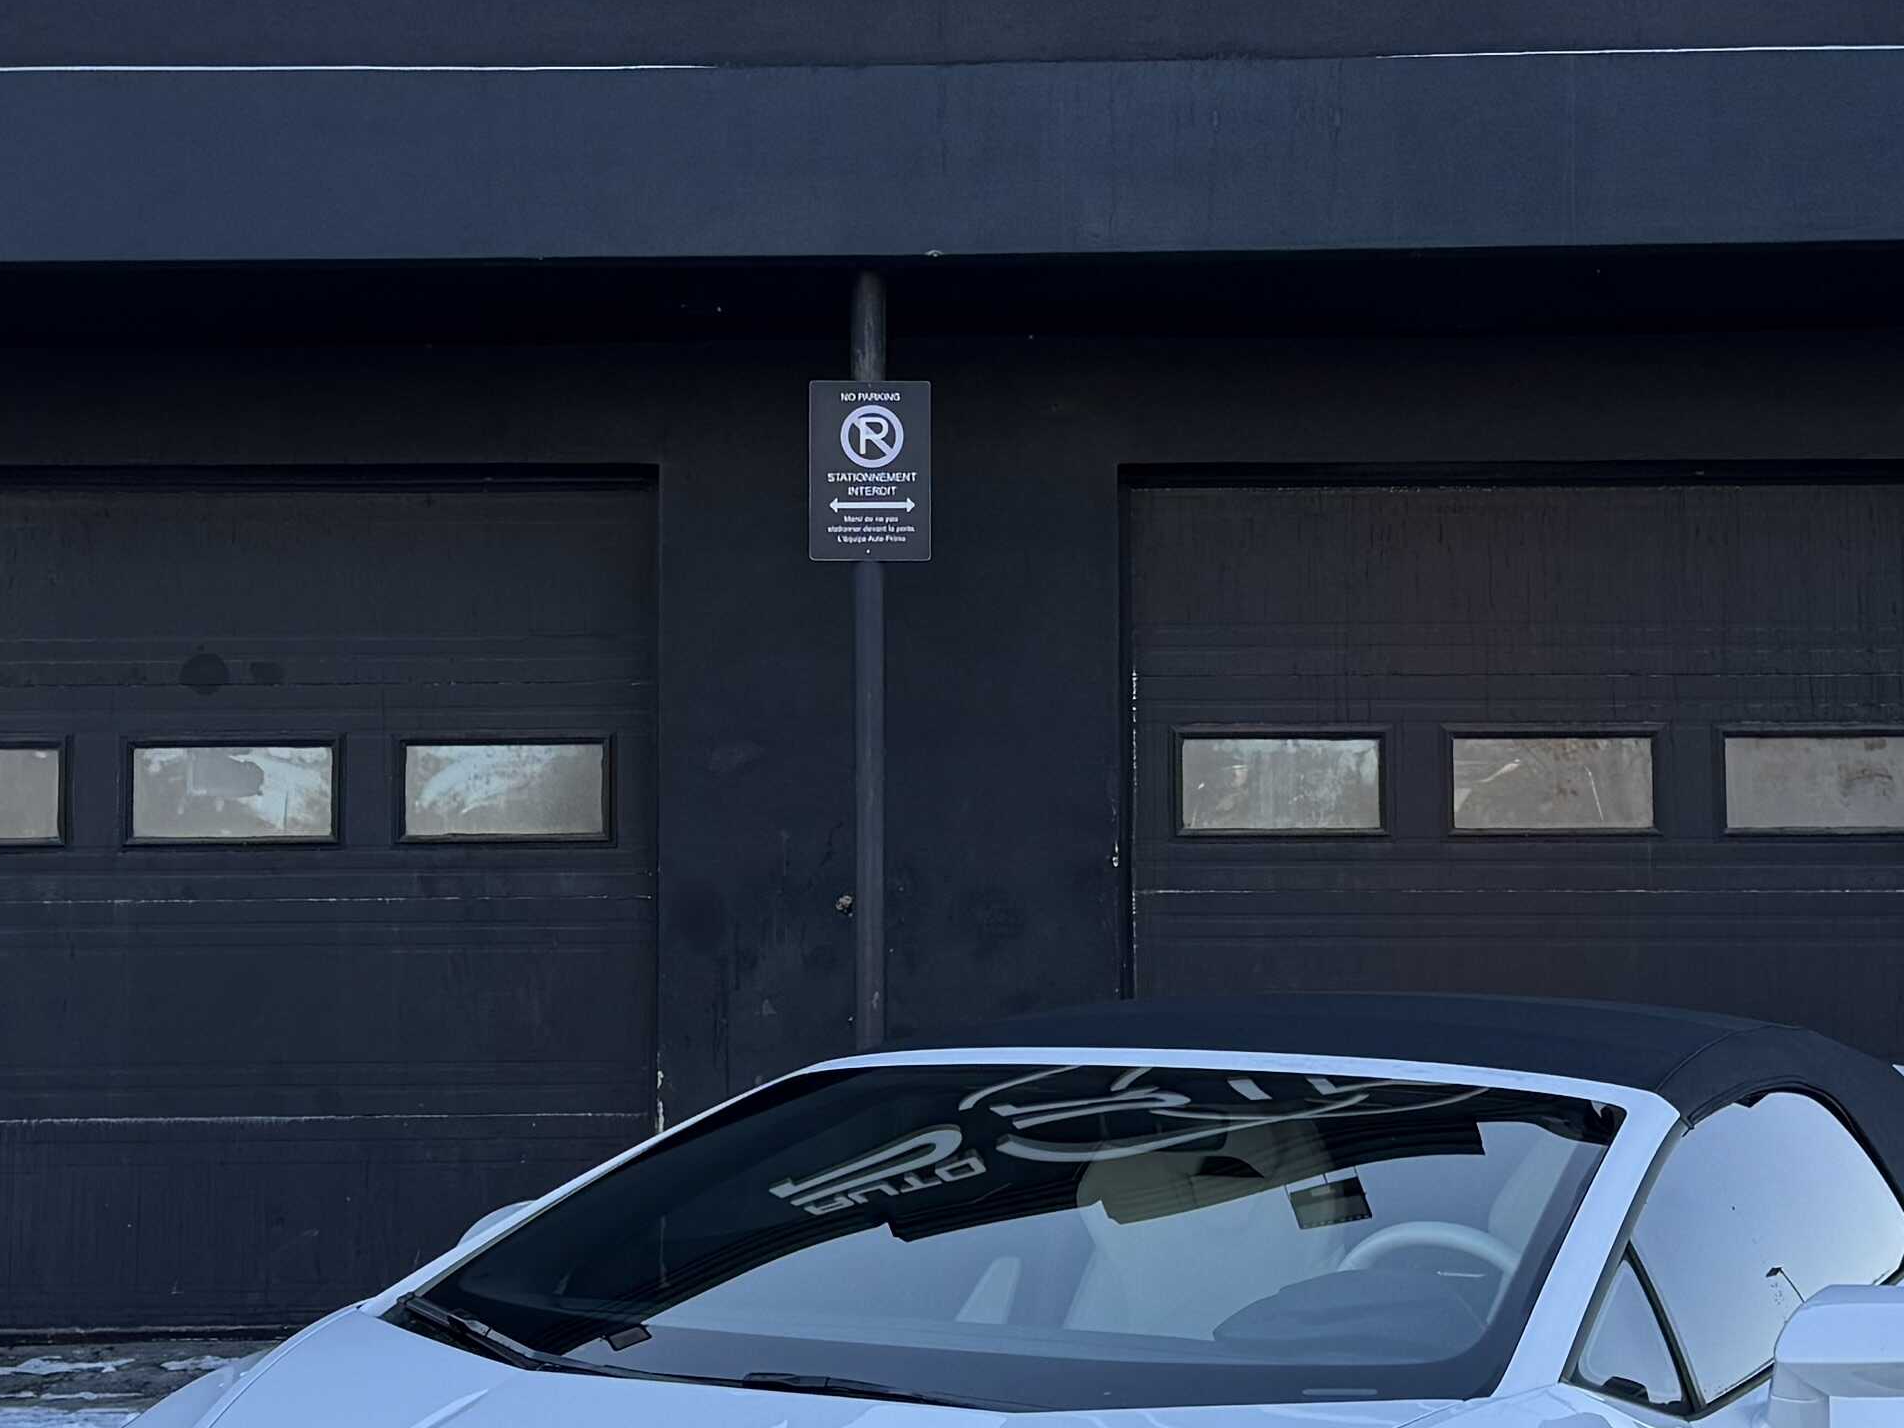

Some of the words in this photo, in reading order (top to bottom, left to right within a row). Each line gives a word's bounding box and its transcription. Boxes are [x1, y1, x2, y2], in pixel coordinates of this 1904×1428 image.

[840, 392, 856, 402] NO
[858, 392, 901, 402] PARKING
[827, 472, 918, 483] STATIONNEMENT
[847, 486, 897, 496] INTERDIT
